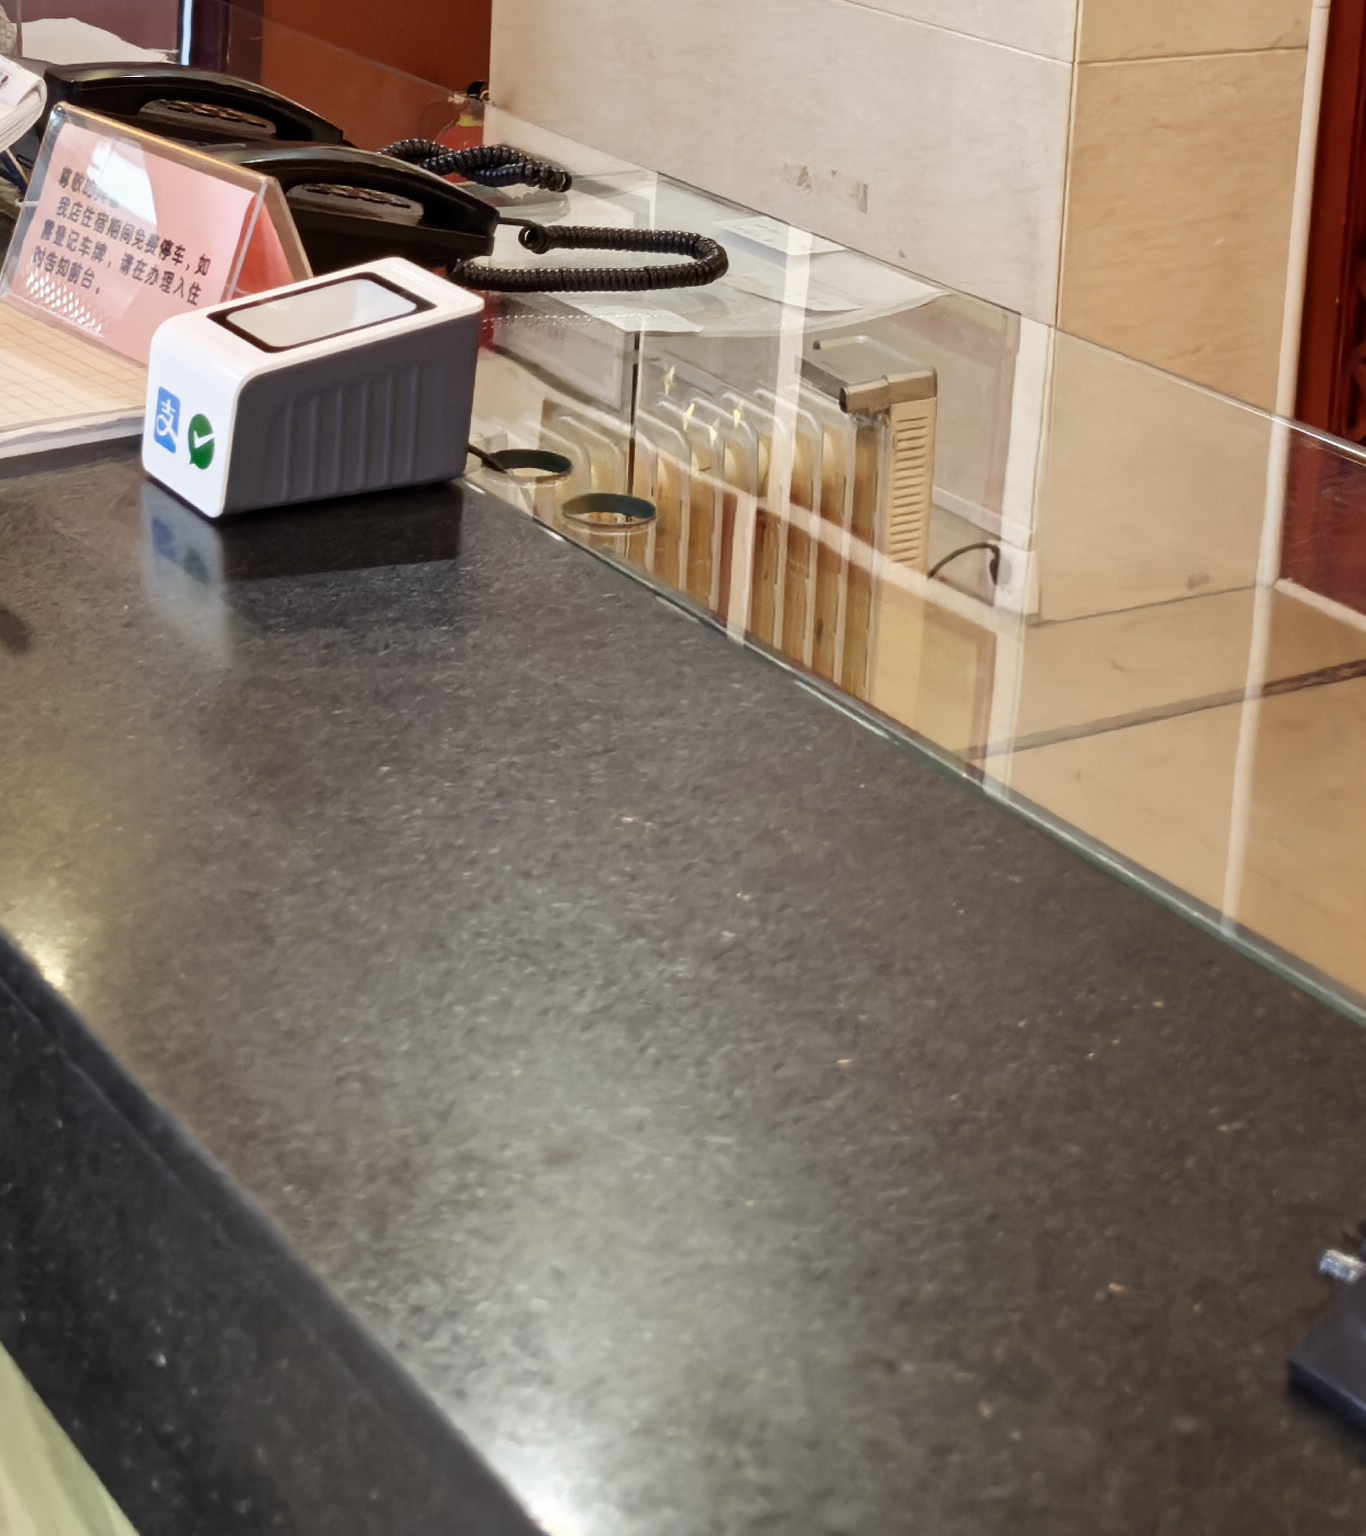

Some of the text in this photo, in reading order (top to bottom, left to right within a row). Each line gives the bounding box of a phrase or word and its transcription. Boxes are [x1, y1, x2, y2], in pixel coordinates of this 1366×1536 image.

[58, 166, 120, 210] 尊敬的
[56, 195, 212, 277] 我店住宿期间免费停车，如
